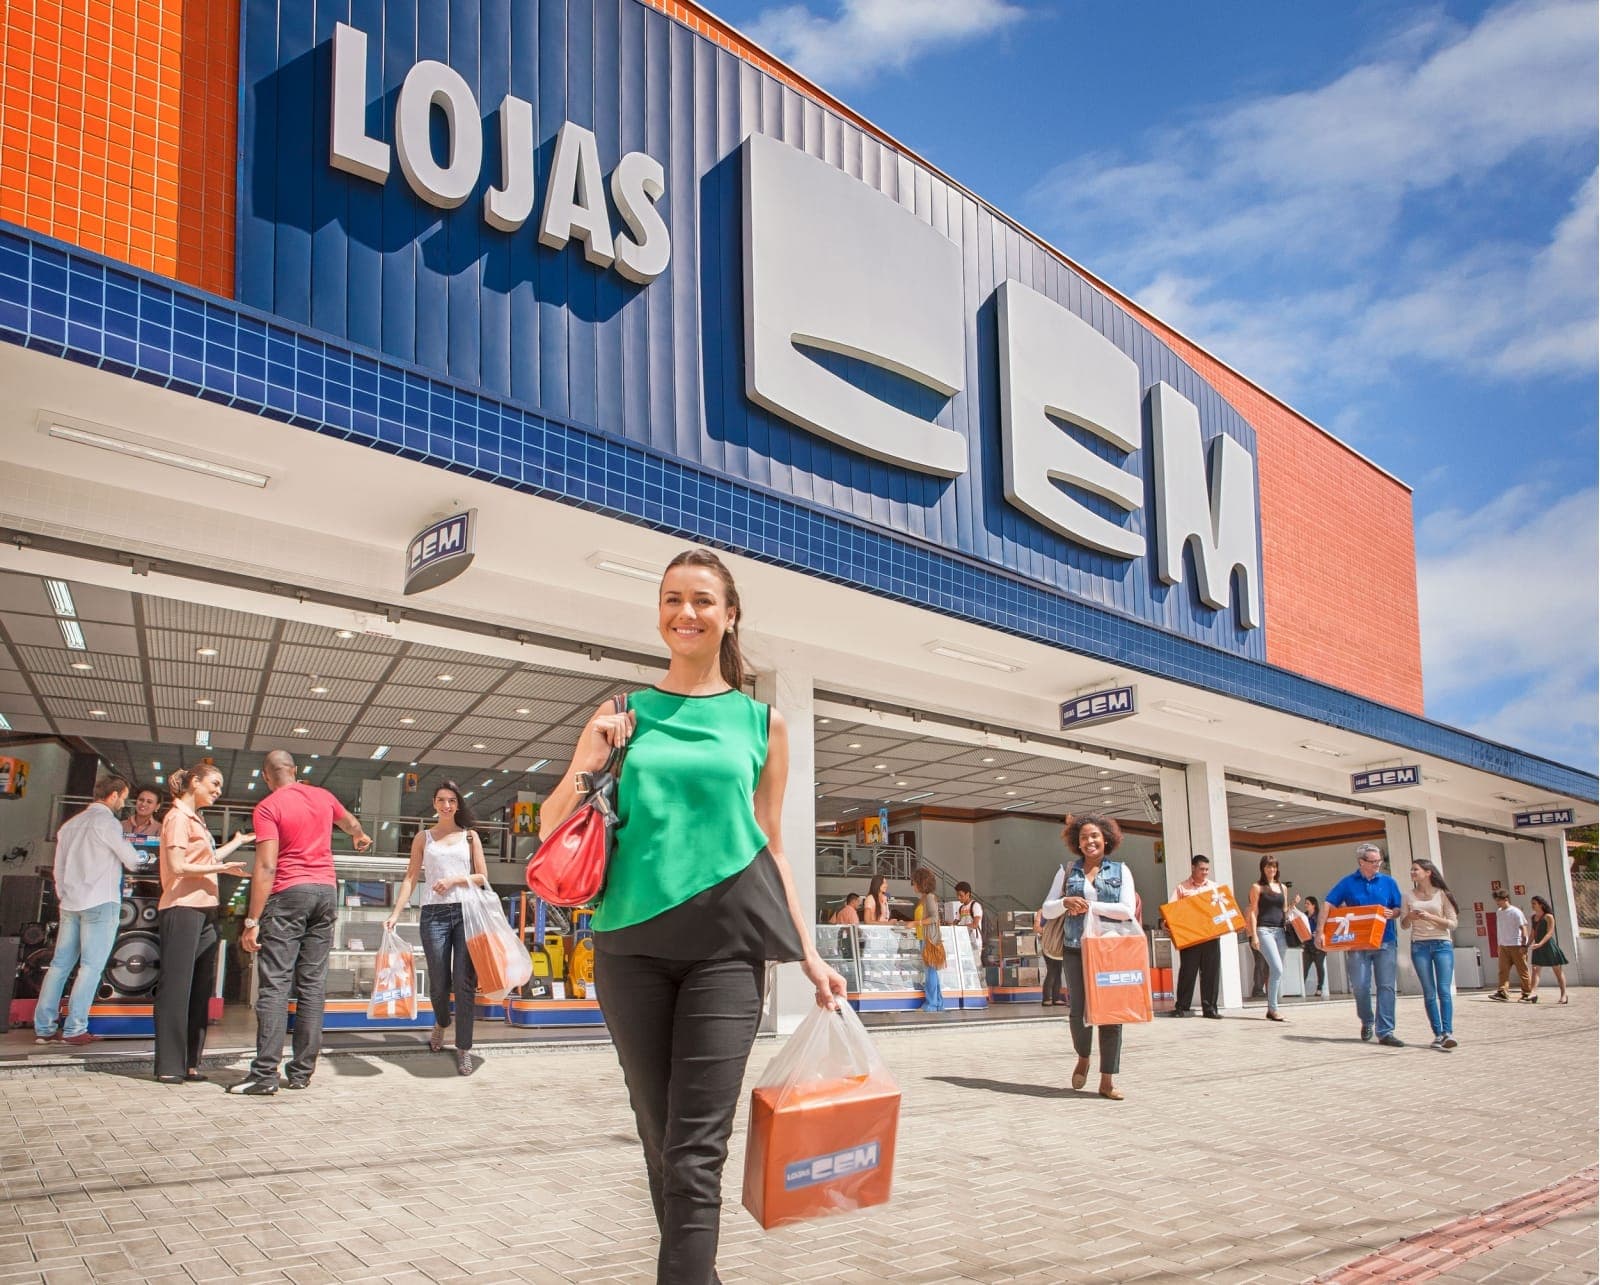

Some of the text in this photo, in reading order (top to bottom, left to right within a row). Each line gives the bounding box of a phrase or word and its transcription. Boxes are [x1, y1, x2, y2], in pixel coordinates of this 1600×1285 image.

[330, 21, 1260, 630] LOJAS CEM
[411, 522, 461, 569] CEM
[1076, 692, 1128, 718] CEM
[1368, 768, 1414, 786] CEM
[1529, 811, 1569, 824] CEM
[1109, 972, 1143, 984] CEM
[811, 1144, 877, 1180] CEM
